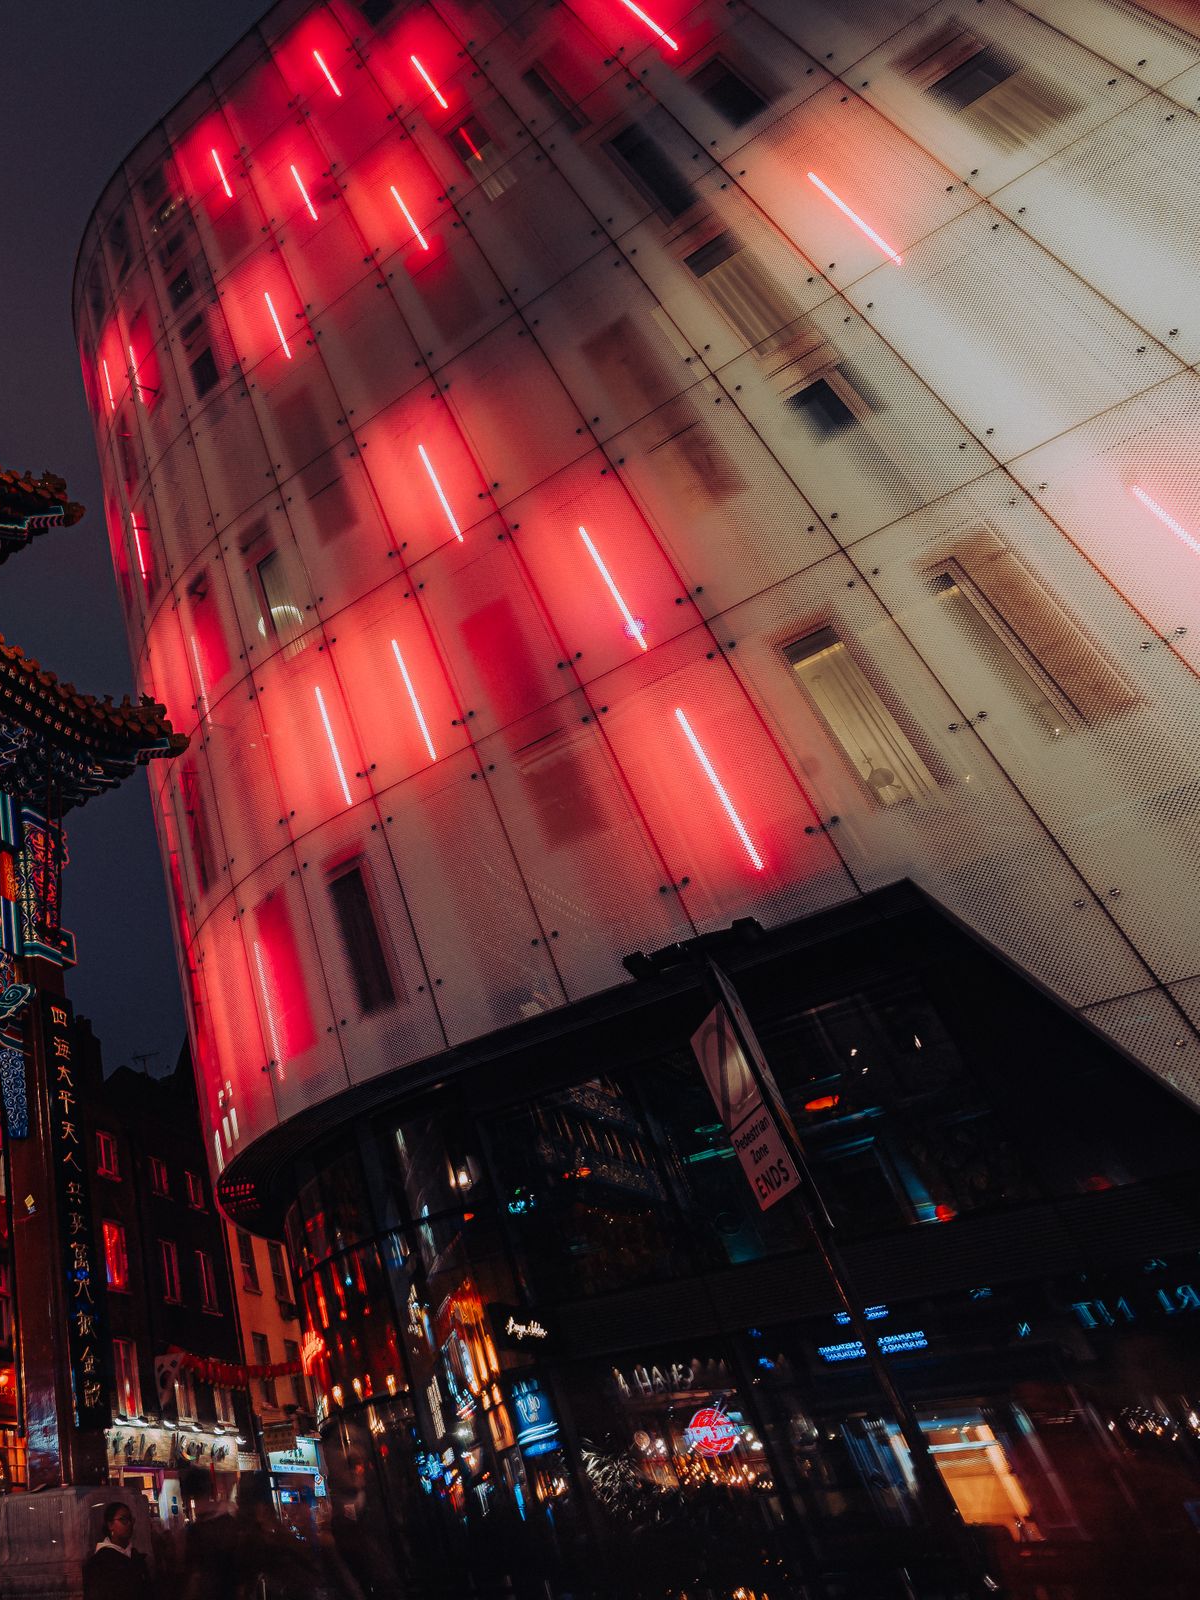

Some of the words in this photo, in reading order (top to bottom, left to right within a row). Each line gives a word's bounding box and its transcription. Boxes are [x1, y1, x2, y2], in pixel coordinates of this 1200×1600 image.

[734, 1115, 770, 1153] Pedestrian
[749, 1143, 770, 1164] Zone
[754, 1158, 790, 1200] ENDS
